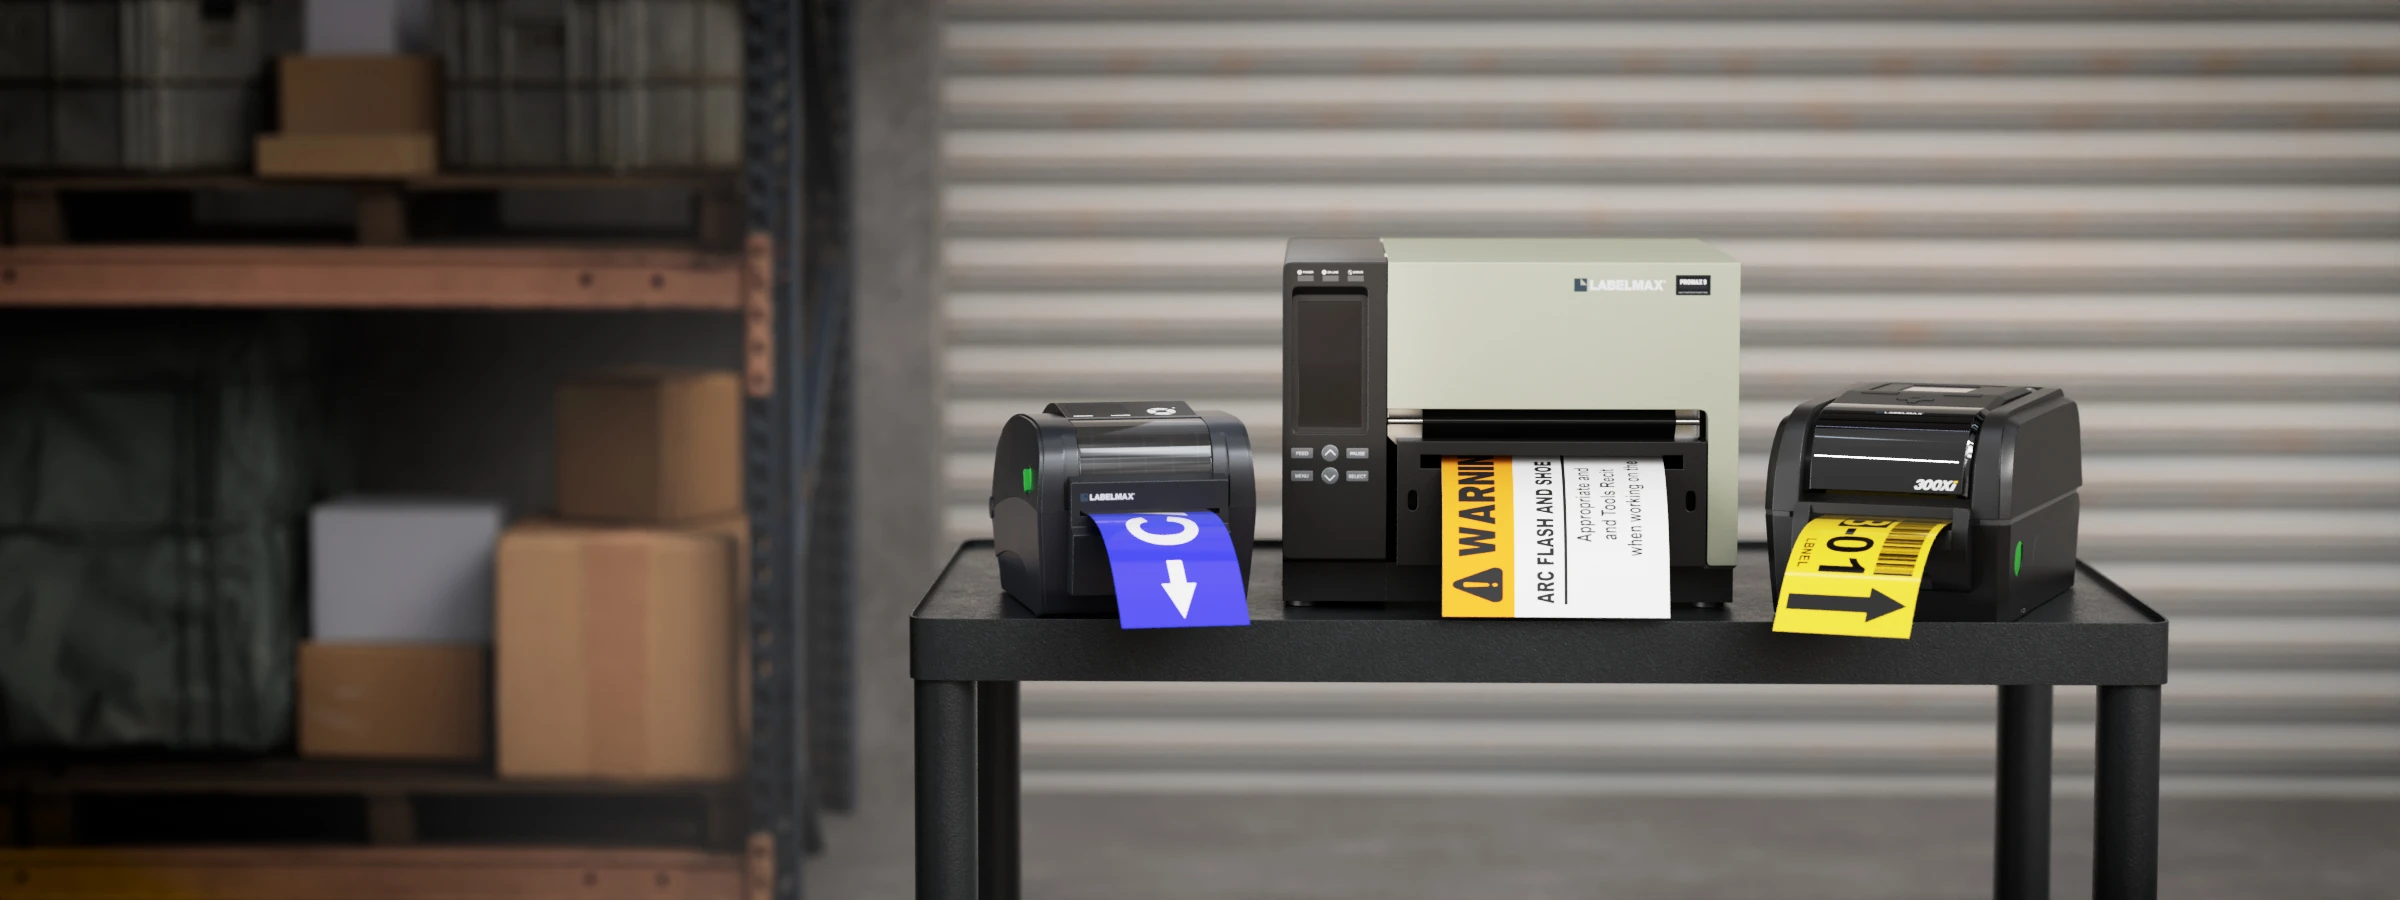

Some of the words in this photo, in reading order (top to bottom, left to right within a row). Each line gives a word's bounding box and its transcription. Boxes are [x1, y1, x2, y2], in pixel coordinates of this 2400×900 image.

[1590, 279, 1665, 291] LABELMAX
[1533, 461, 1553, 486] SHOE
[1573, 467, 1590, 481] and
[1622, 460, 1639, 471] the
[1627, 472, 1640, 482] on
[1089, 492, 1135, 502] LABELMAX
[1913, 478, 1959, 492] 300Xi
[1535, 488, 1554, 514] AND
[1575, 482, 1596, 543] Appropriate
[1600, 490, 1617, 516] Tools
[1624, 483, 1645, 523] working
[1125, 512, 1199, 546] C
[1536, 518, 1555, 565] FLASH
[1601, 520, 1618, 541] and
[1627, 525, 1643, 557] when
[1797, 537, 1817, 568] LBNEL
[1537, 571, 1555, 604] ARC
